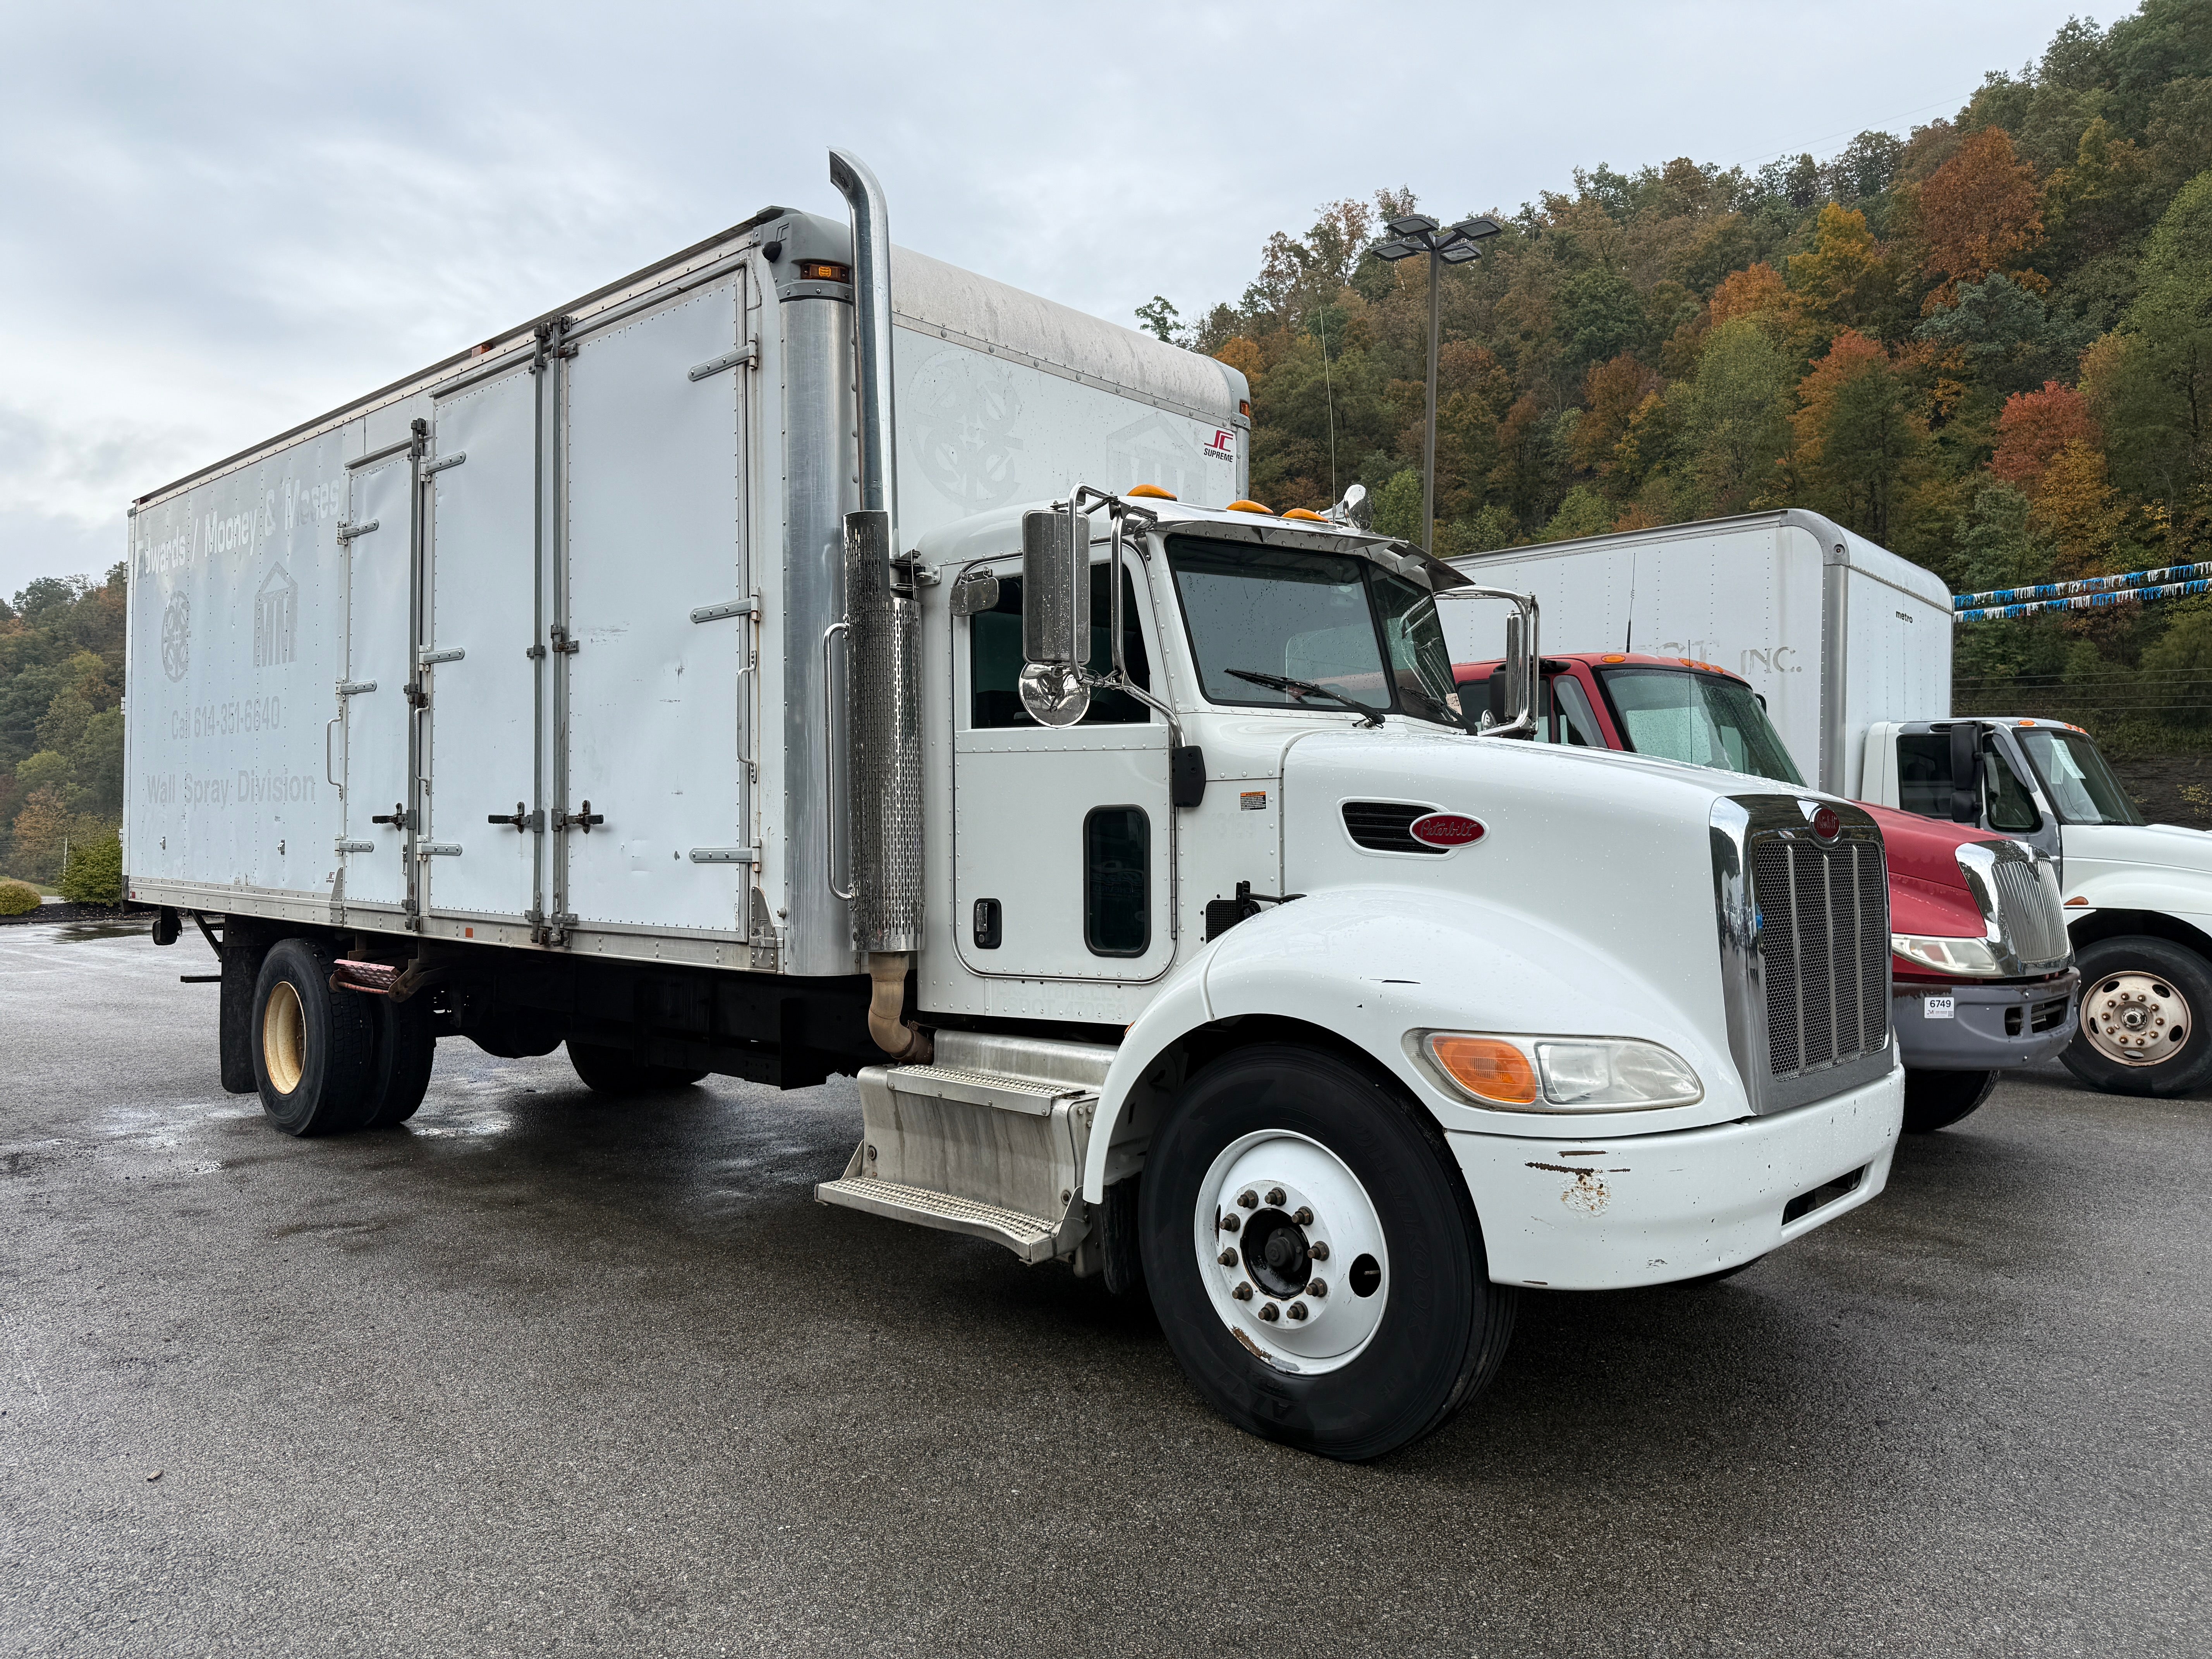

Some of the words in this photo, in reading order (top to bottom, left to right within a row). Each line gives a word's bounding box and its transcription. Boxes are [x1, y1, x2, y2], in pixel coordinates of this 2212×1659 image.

[1204, 448, 1233, 462] SUPREME
[136, 526, 185, 580] Edwards
[204, 509, 257, 556] Mooney
[265, 489, 276, 536] &
[285, 479, 340, 530] Moses
[1896, 611, 1913, 623] metro
[1741, 647, 1802, 675] INC.
[172, 708, 190, 740] Call
[194, 696, 280, 738] 614-351-6640
[147, 775, 175, 804] Wall
[185, 773, 229, 811] Spray
[238, 768, 315, 802] Division
[1420, 820, 1478, 837] Peterbilt
